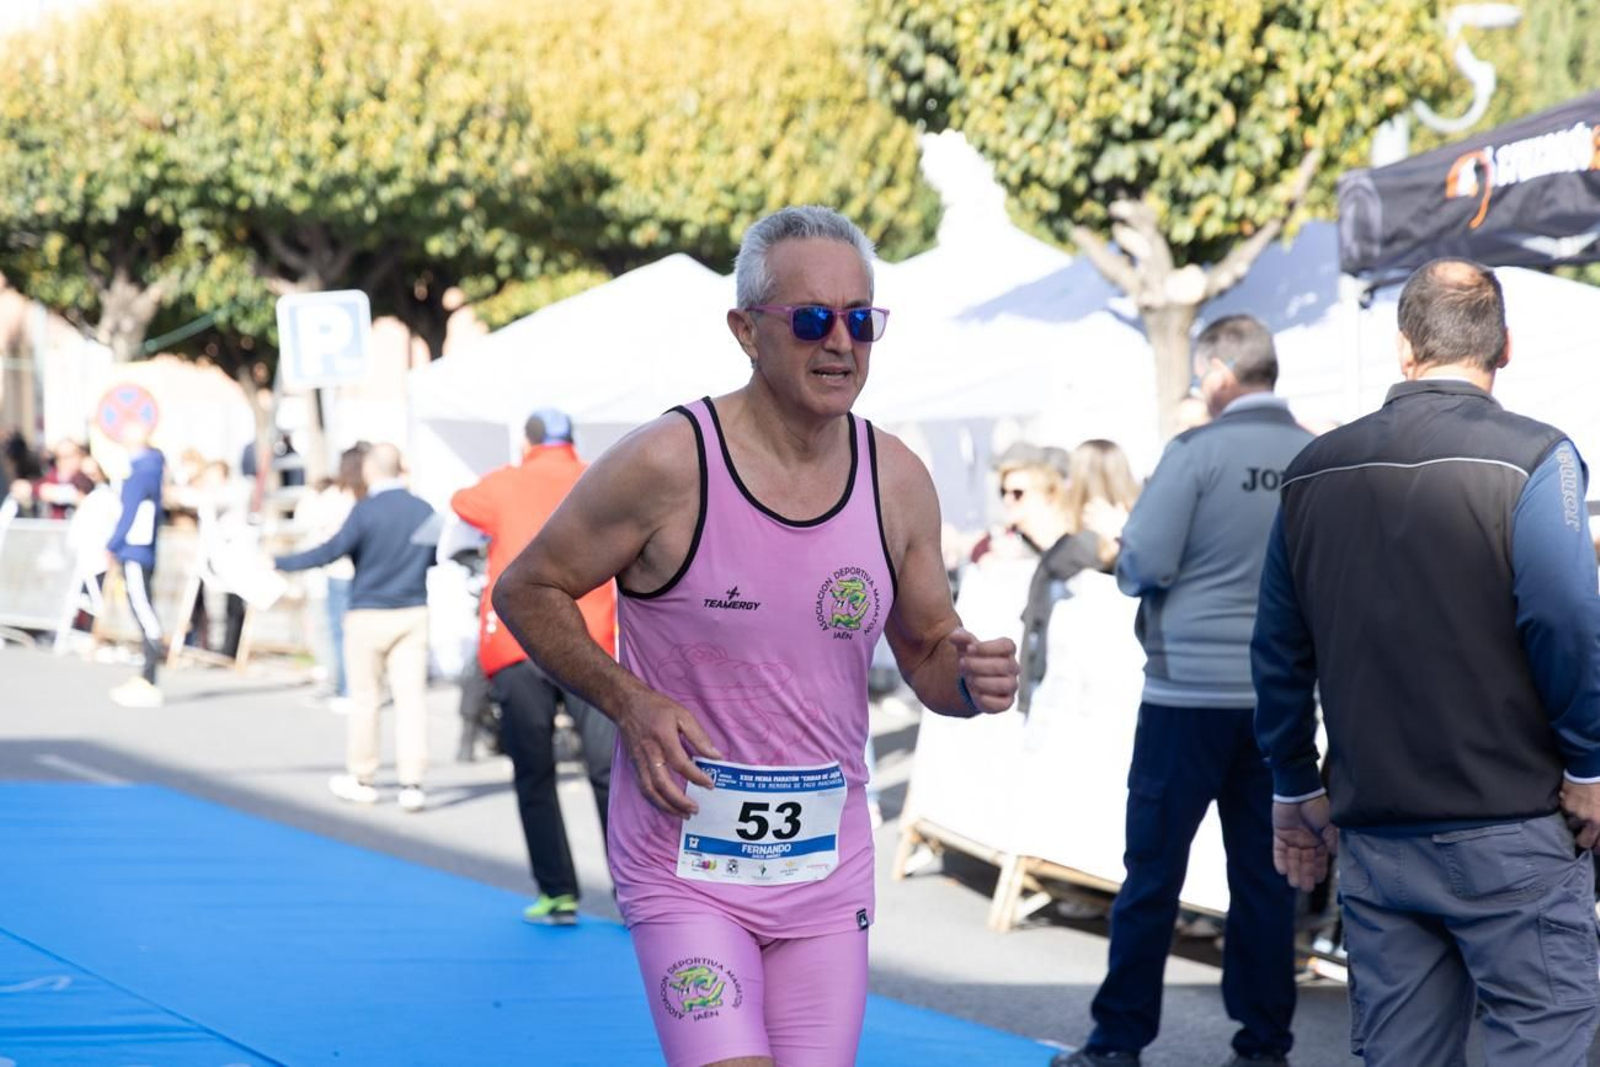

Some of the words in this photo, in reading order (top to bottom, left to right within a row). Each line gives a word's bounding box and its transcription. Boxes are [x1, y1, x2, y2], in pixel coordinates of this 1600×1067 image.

[296, 306, 354, 376] P
[833, 566, 874, 588] DEPORTIVA
[703, 598, 761, 611] TEAMERGY
[735, 801, 802, 841] 53
[741, 843, 791, 855] FERNANDO
